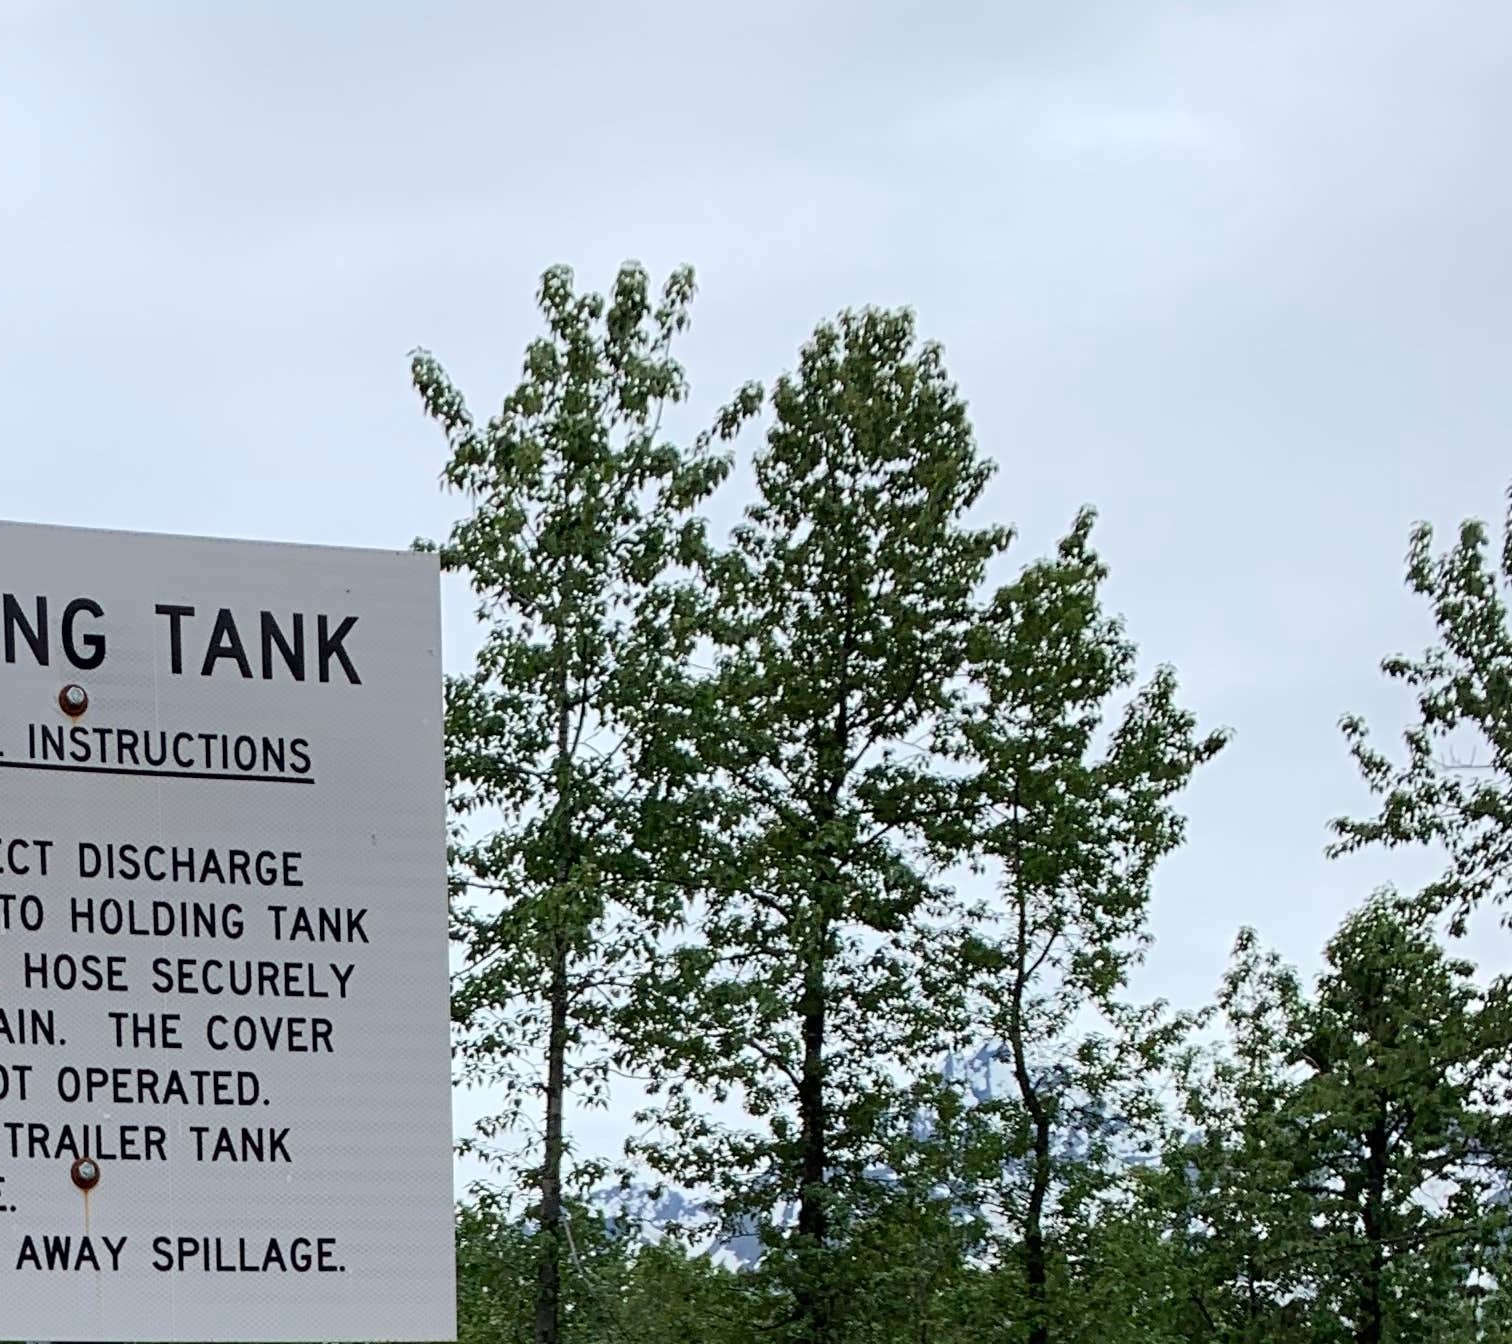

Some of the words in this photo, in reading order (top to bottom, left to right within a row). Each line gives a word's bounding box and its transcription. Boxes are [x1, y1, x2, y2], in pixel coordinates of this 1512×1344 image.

[154, 604, 363, 686] TANK
[28, 725, 312, 774] INSTRUCTIONS
[78, 842, 304, 887] DISCHARGE
[0, 895, 45, 932] TO
[70, 899, 244, 941] HOLDING
[267, 906, 370, 943] TANK
[23, 953, 129, 993] HOSE
[152, 959, 356, 999] SECURELY
[108, 1013, 181, 1050] THE
[206, 1016, 335, 1053] COVER
[57, 1066, 271, 1106] OPERATED.
[4, 1123, 167, 1162] TRAILER
[190, 1126, 291, 1163] TANK
[16, 1236, 128, 1272] AWAY
[152, 1236, 346, 1272] SPILLAGE.
